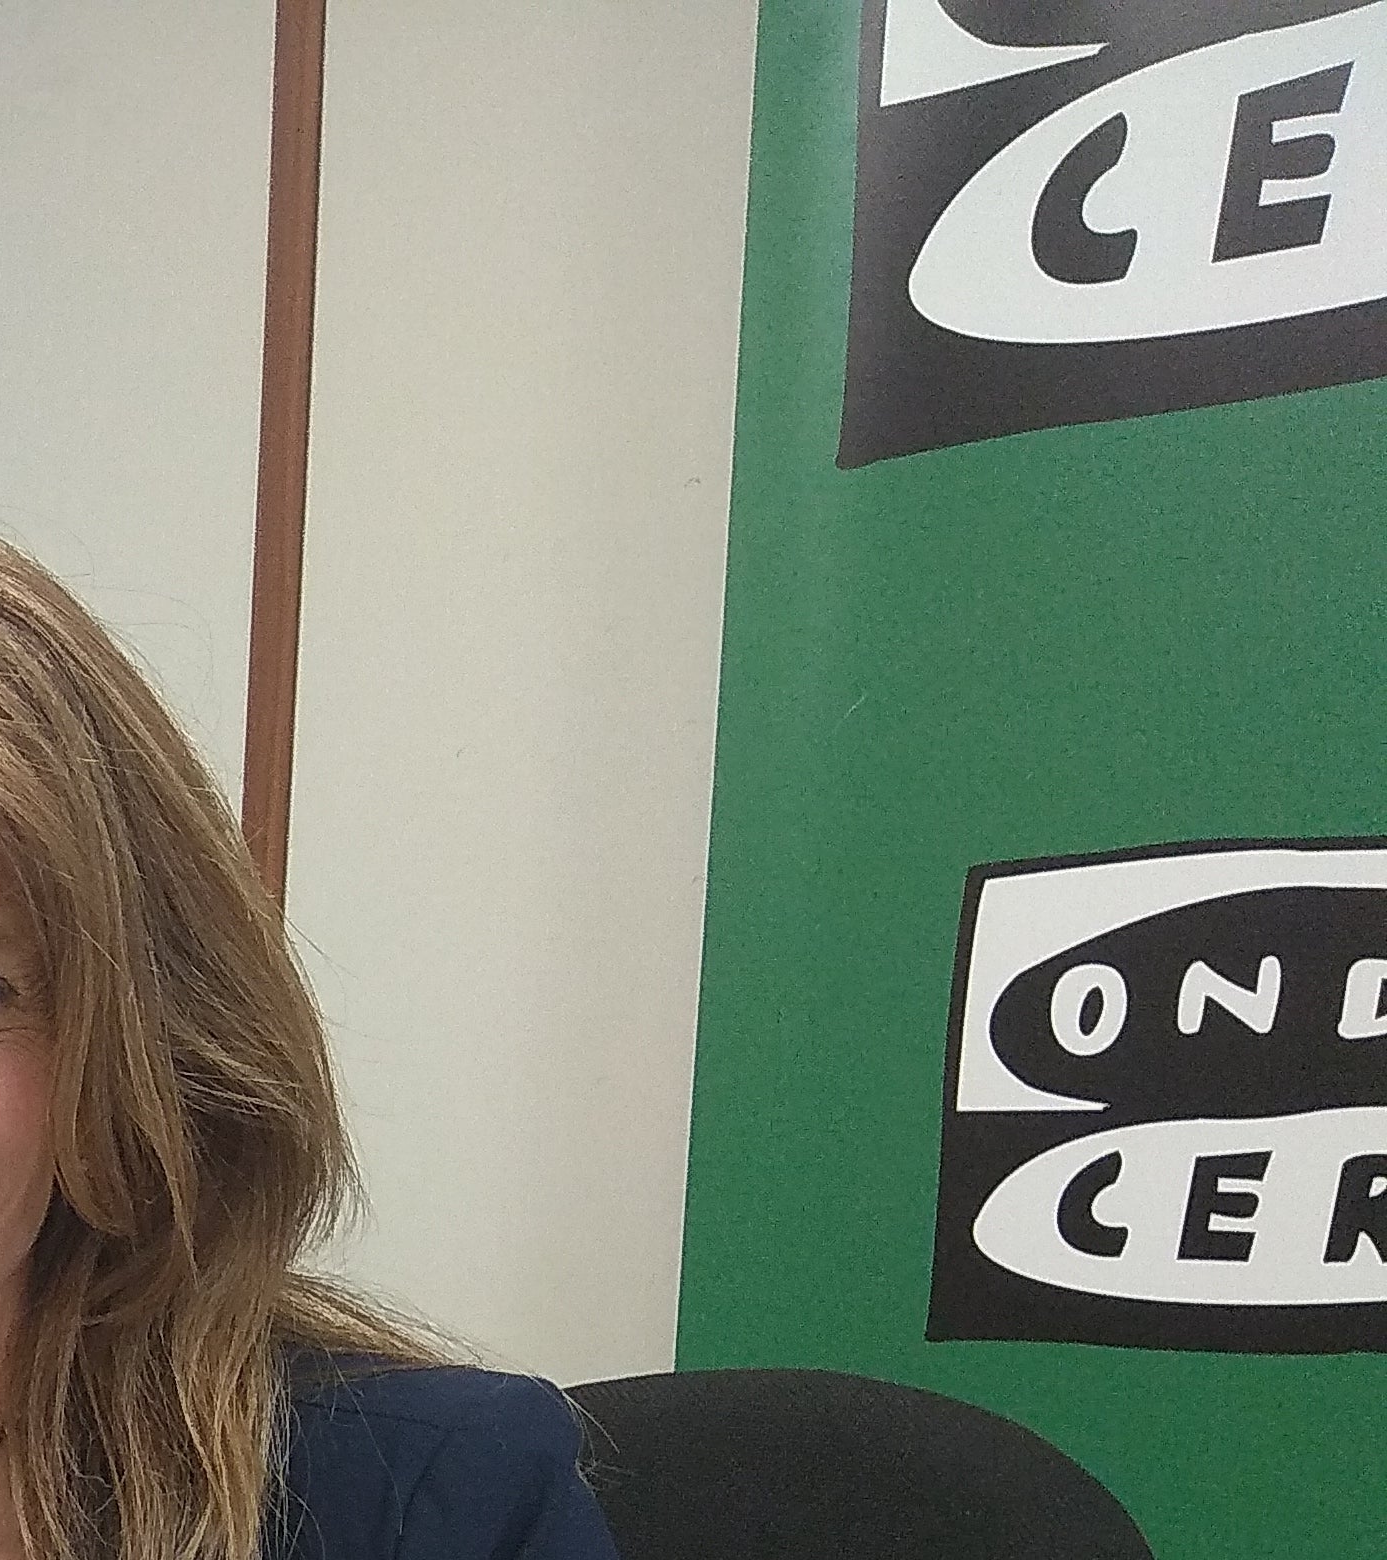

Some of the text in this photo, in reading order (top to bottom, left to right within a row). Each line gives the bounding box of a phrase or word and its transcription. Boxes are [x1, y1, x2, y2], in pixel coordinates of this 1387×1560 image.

[1032, 60, 1356, 287] CE
[1050, 955, 1387, 1056] OND
[1056, 1149, 1387, 1264] CER
